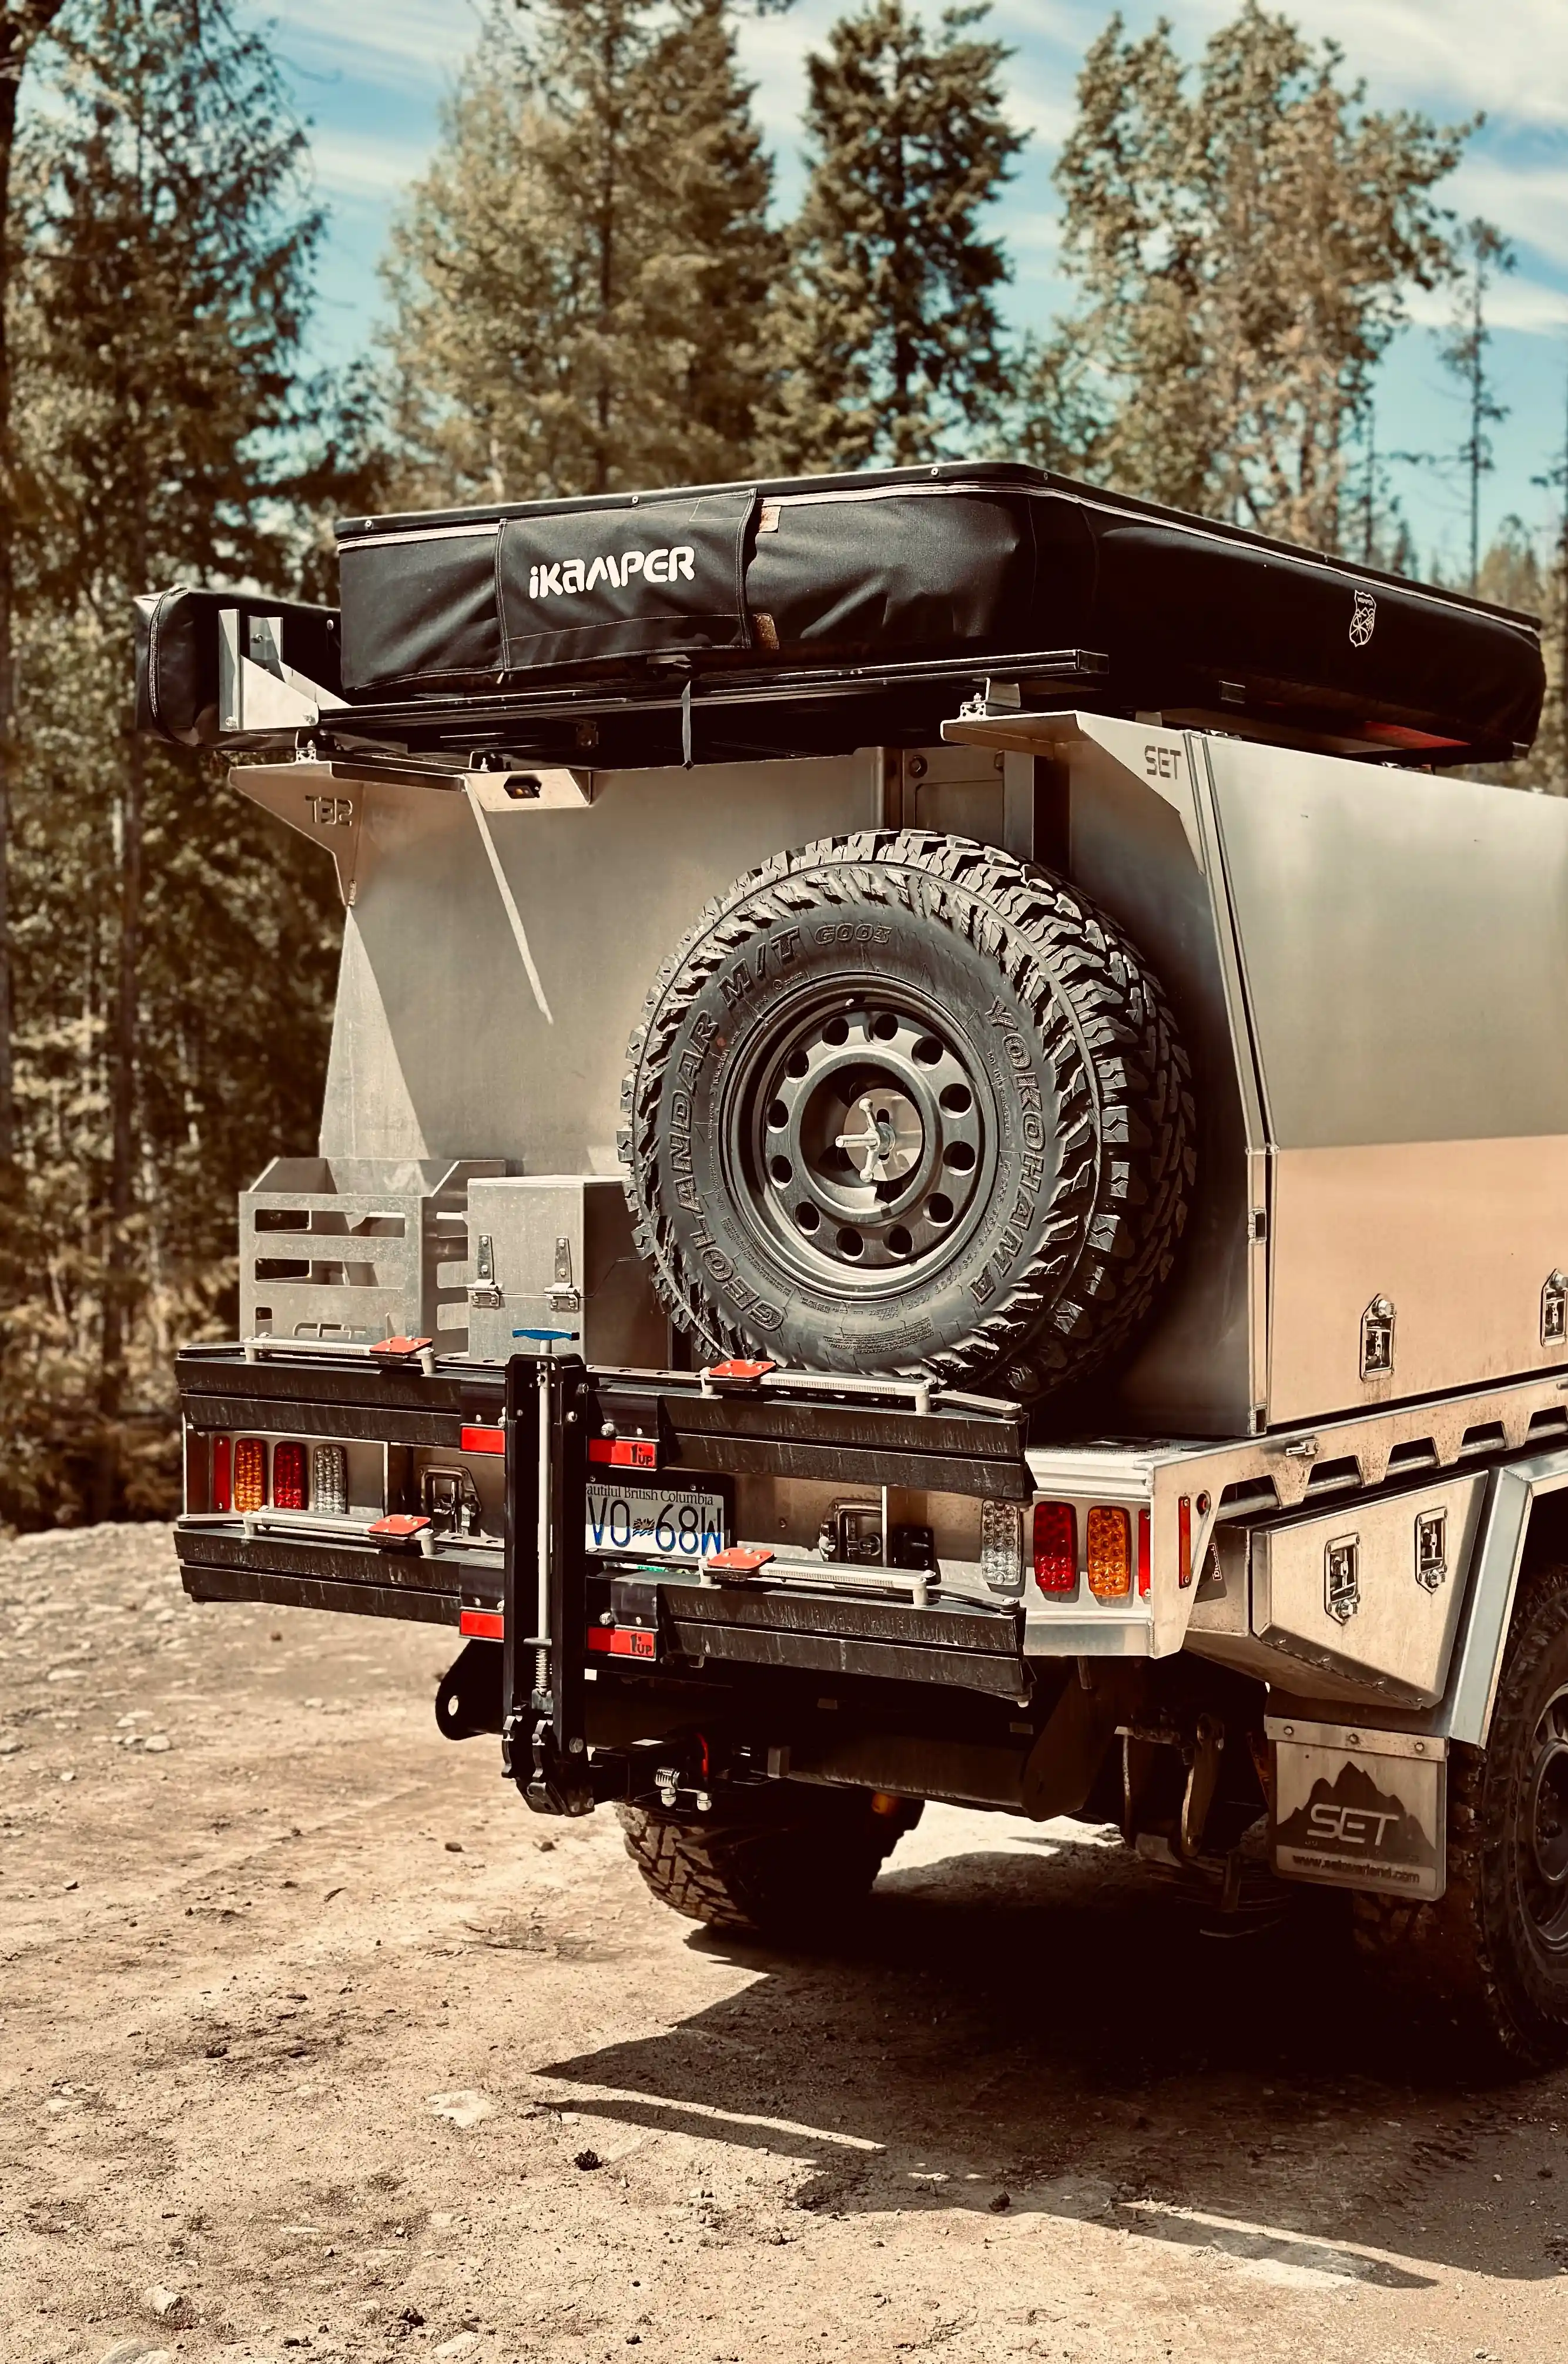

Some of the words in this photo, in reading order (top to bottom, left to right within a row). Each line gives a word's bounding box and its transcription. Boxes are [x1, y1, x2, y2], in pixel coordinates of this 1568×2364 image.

[1145, 745, 1182, 780] SET
[717, 925, 800, 1007] M/T
[669, 1010, 784, 1332] GEOLANDAR
[967, 995, 1046, 1305] YOKOHAMA
[586, 1485, 621, 1498] autiful
[624, 1487, 658, 1501] British
[661, 1489, 713, 1506] Columbia
[655, 1503, 721, 1556] 68W
[1306, 1803, 1400, 1846] SET
